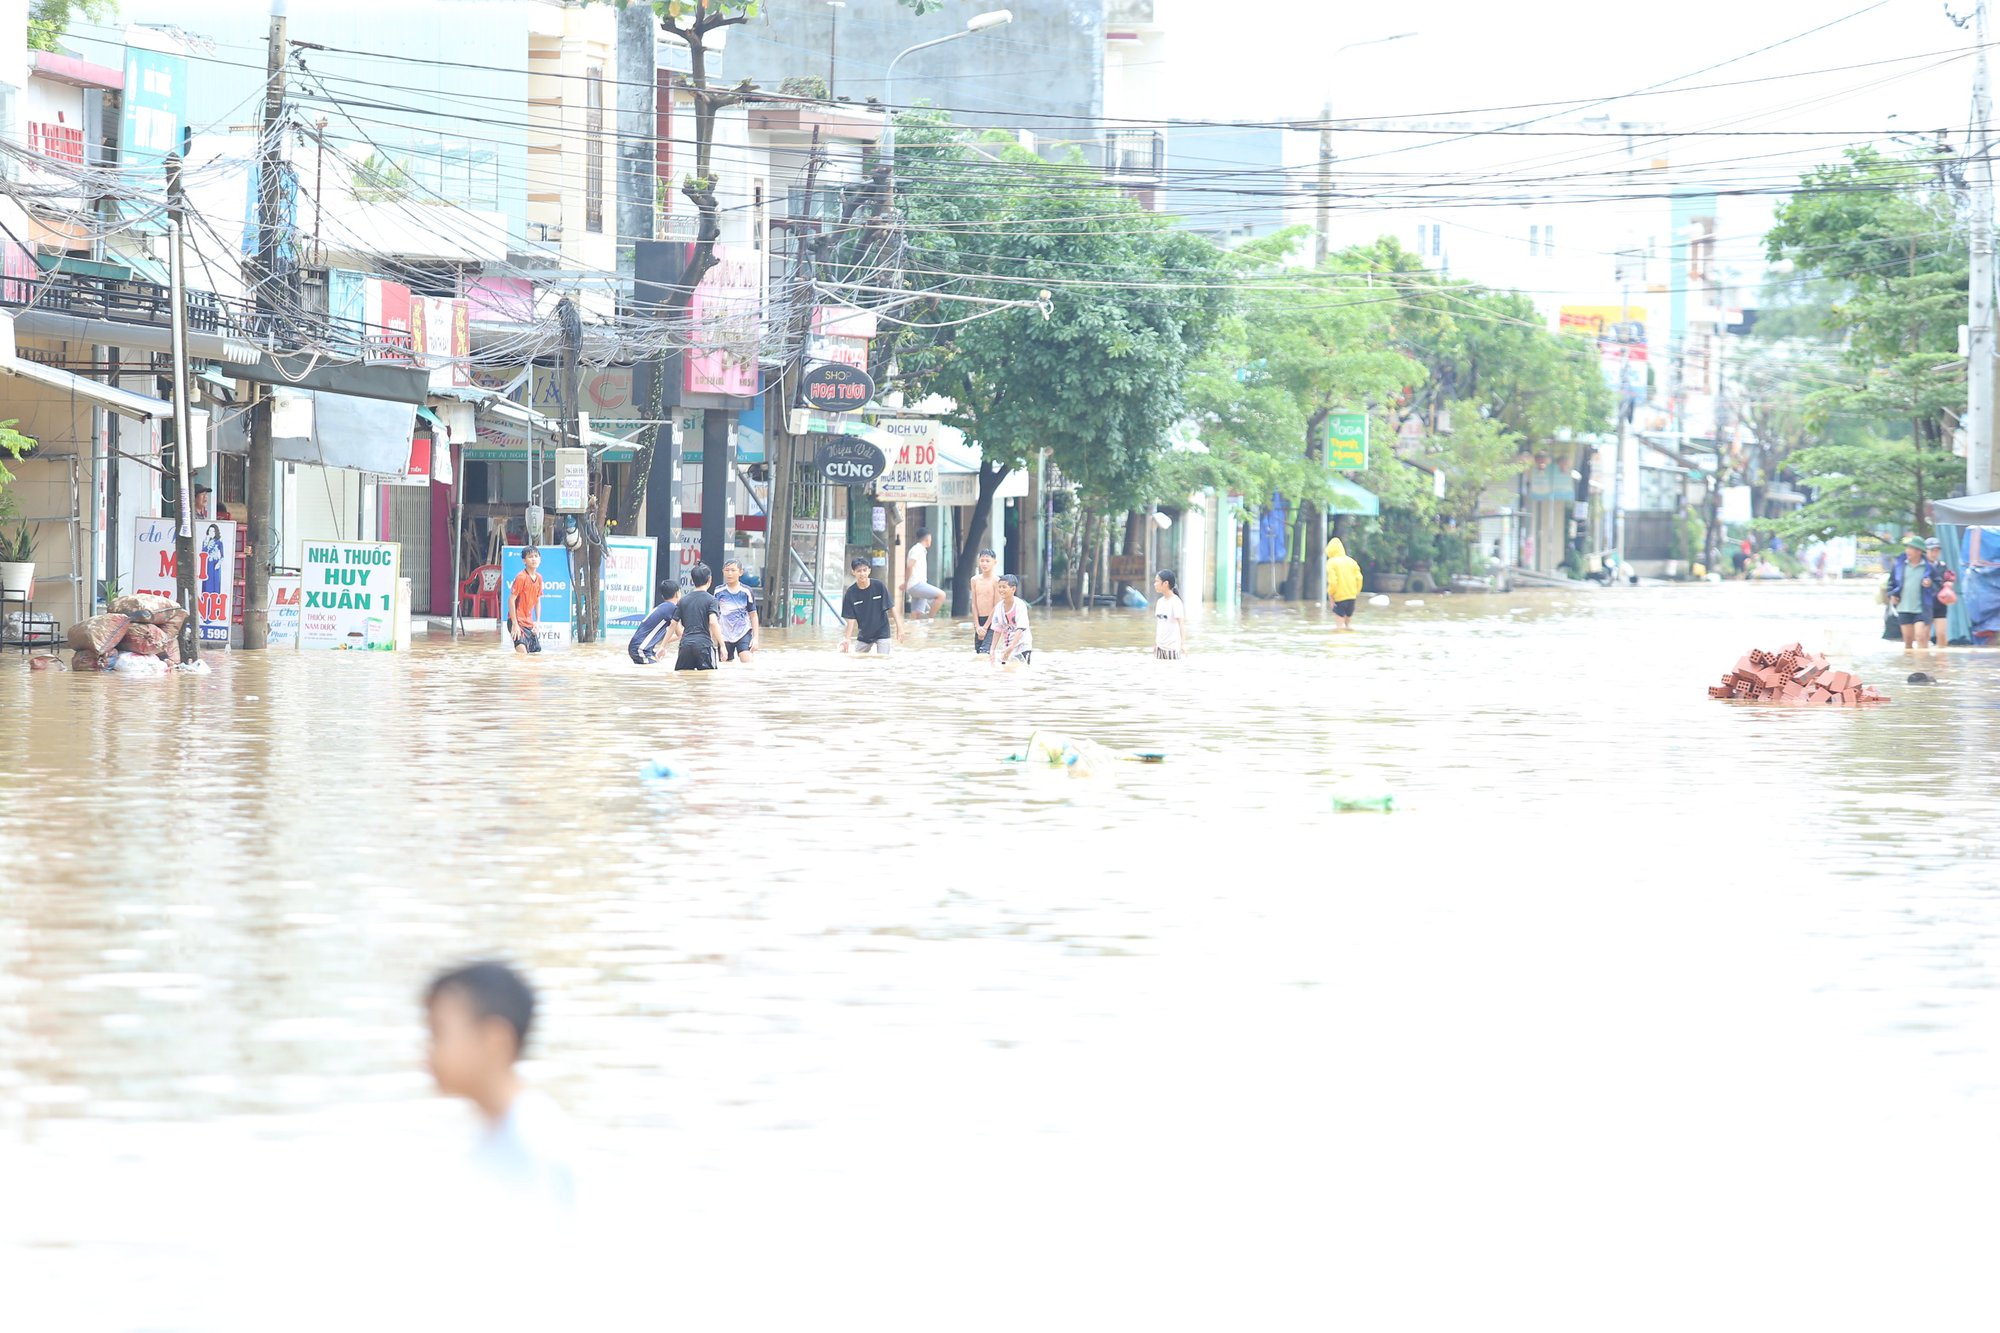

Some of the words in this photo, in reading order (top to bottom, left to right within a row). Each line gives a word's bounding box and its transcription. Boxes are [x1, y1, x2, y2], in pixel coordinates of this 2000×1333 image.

[887, 424, 911, 435] DỊCH
[914, 425, 928, 436] VỤ
[915, 437, 935, 465] ĐỒ
[825, 460, 874, 478] CƯNG
[897, 468, 911, 482] BÁN
[913, 470, 922, 483] XE
[158, 550, 209, 580] MI
[308, 545, 339, 564] NHÀ
[344, 544, 392, 566] THUỐC
[324, 568, 371, 586] HUY
[305, 588, 371, 610] XUÂN
[379, 594, 390, 611] 1
